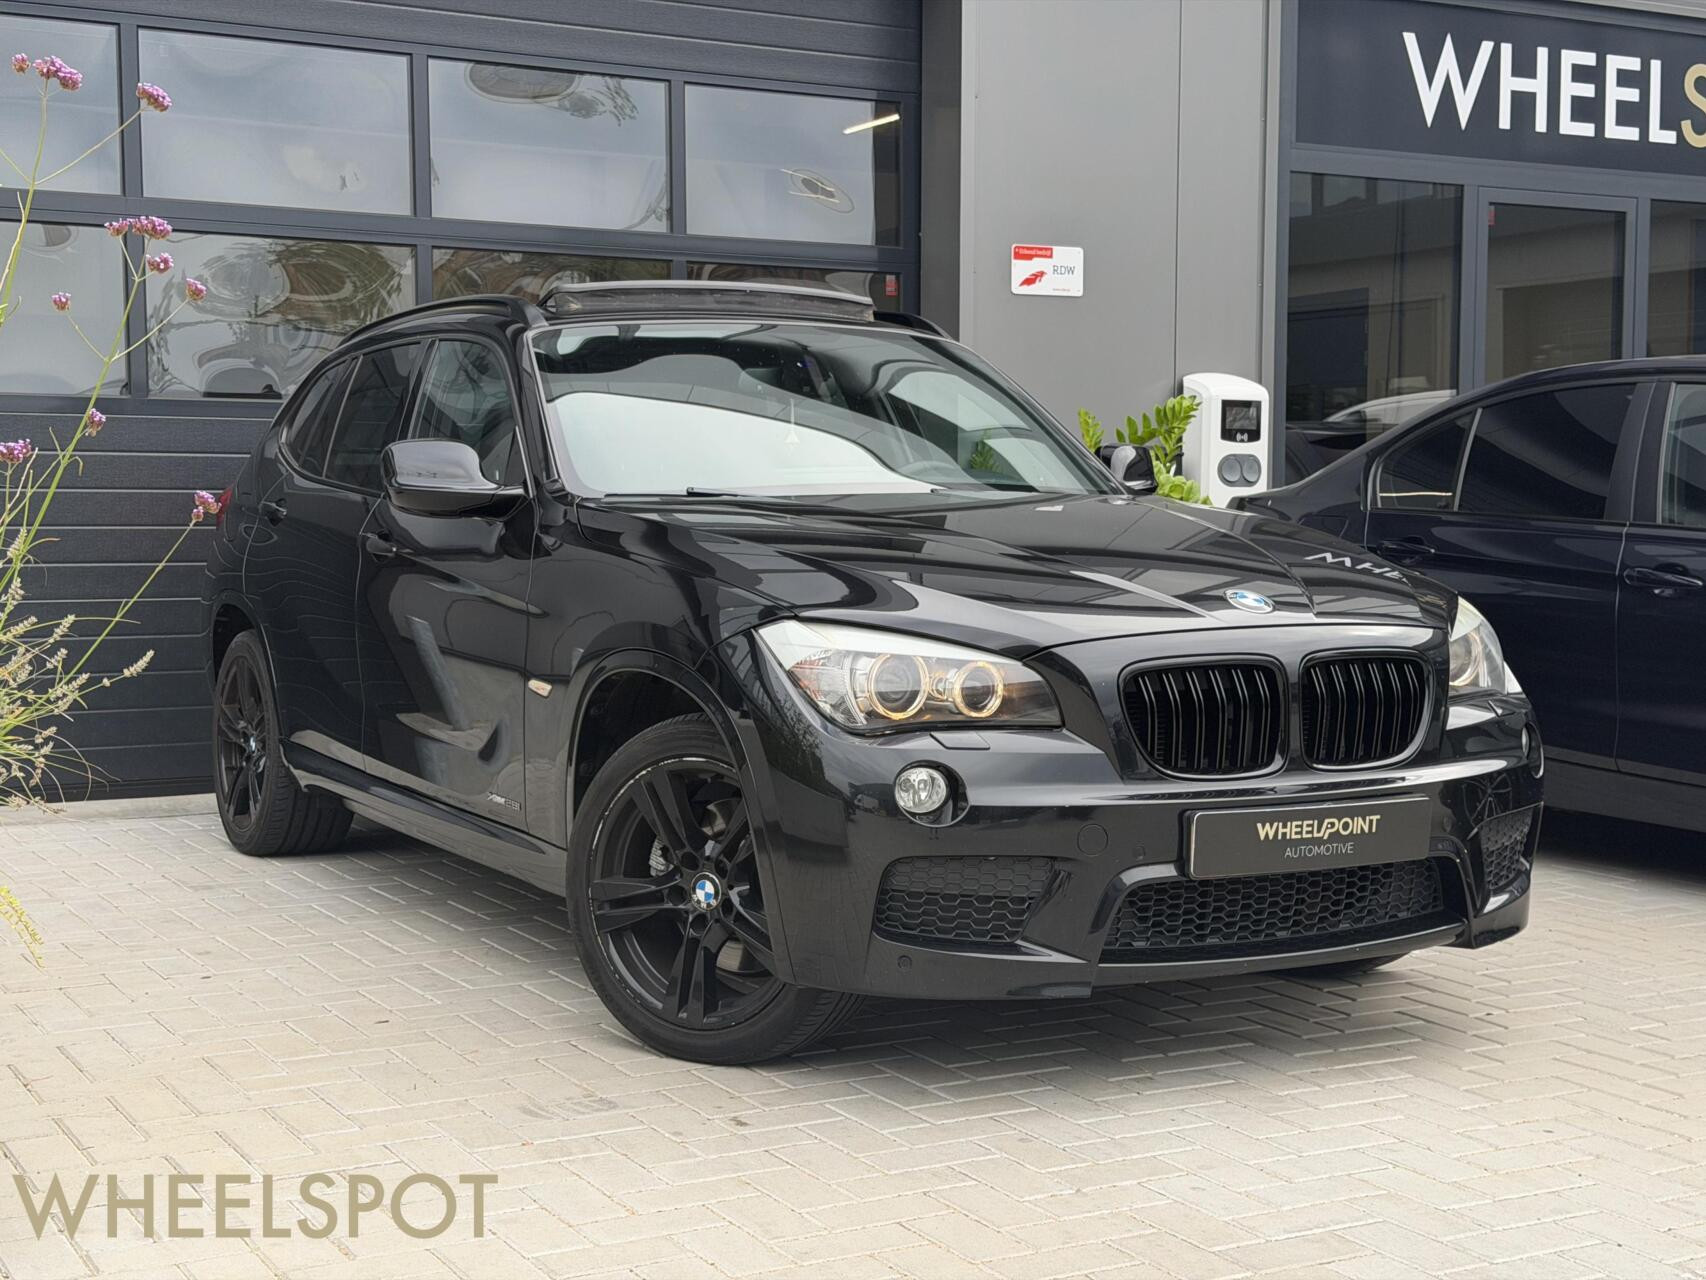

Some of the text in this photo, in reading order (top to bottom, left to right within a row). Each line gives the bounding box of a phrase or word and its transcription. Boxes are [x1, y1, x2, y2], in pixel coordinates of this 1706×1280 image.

[1402, 31, 1706, 148] WHEELS
[1052, 265, 1076, 276] RDW
[1256, 815, 1381, 840] WHEELPOINT
[1284, 842, 1354, 859] AUTOMOTIVE
